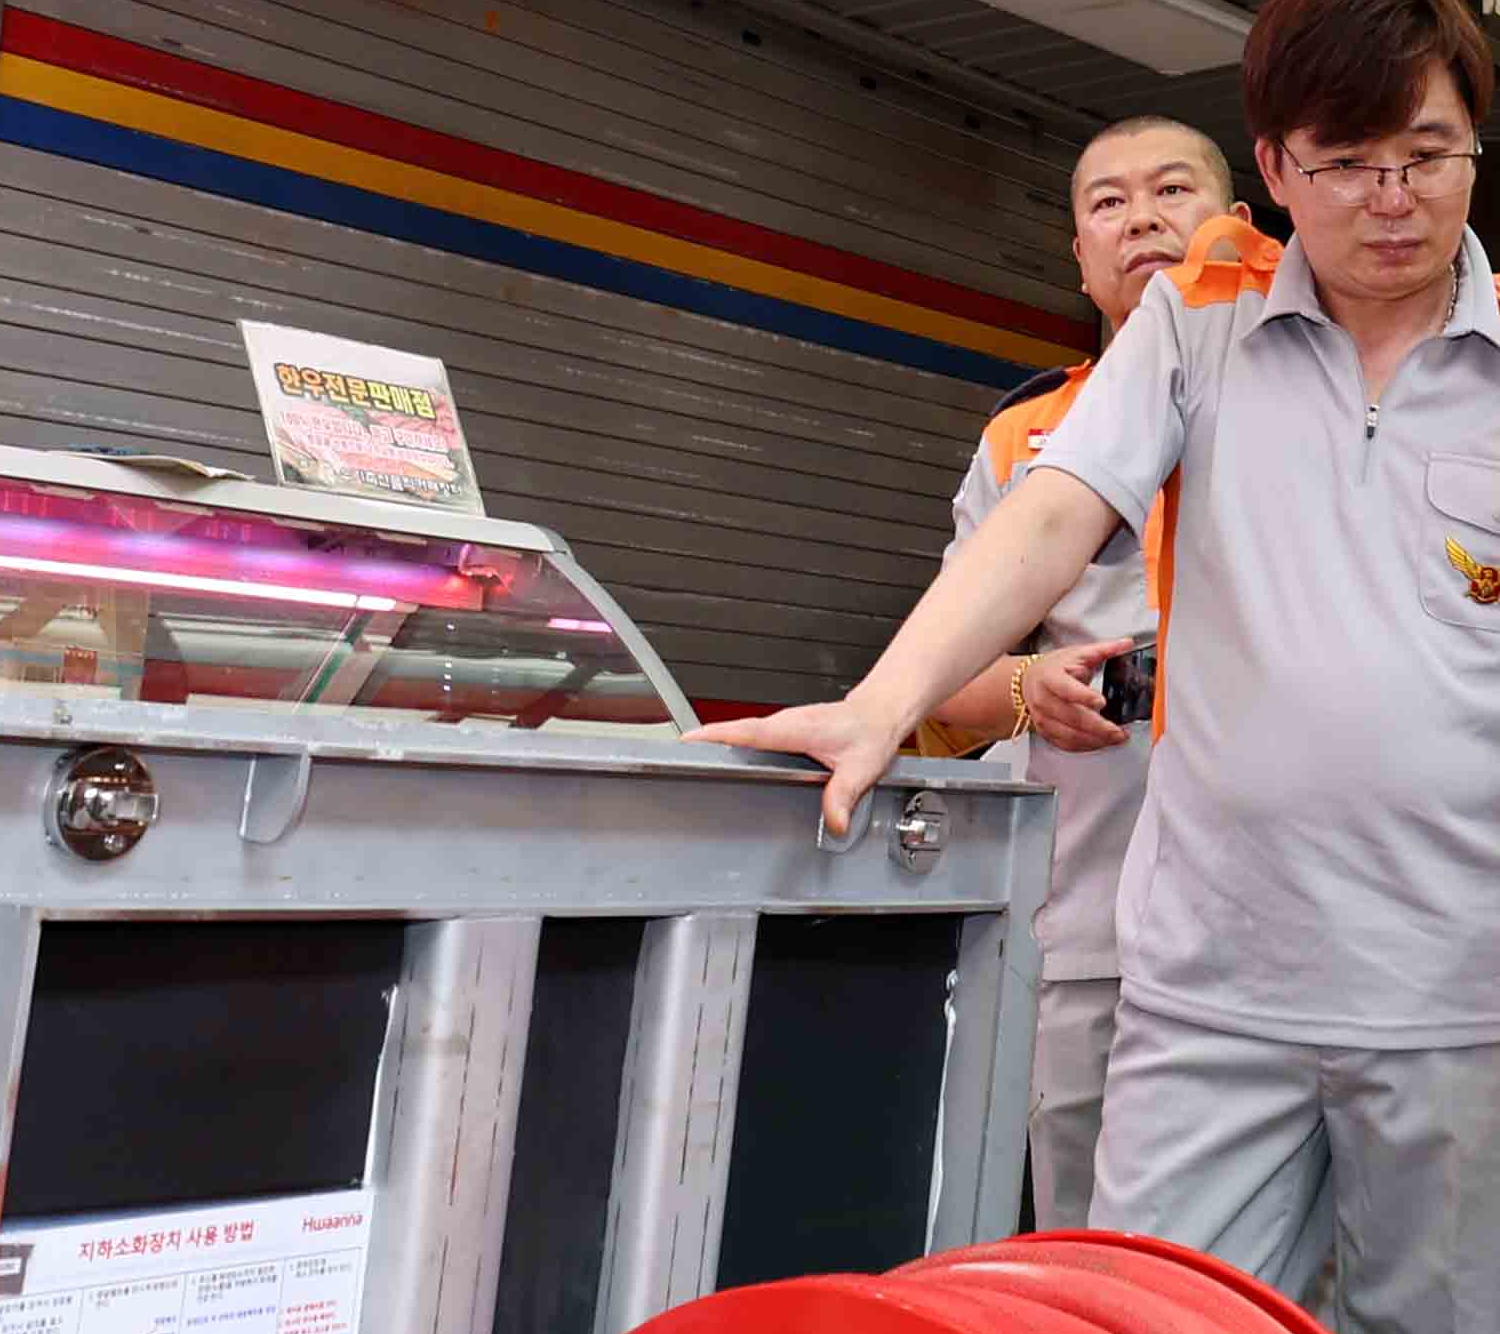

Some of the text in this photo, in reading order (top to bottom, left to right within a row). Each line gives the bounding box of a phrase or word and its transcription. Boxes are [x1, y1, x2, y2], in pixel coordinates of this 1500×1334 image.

[78, 1218, 256, 1262] 지하소화장치 사용 방법
